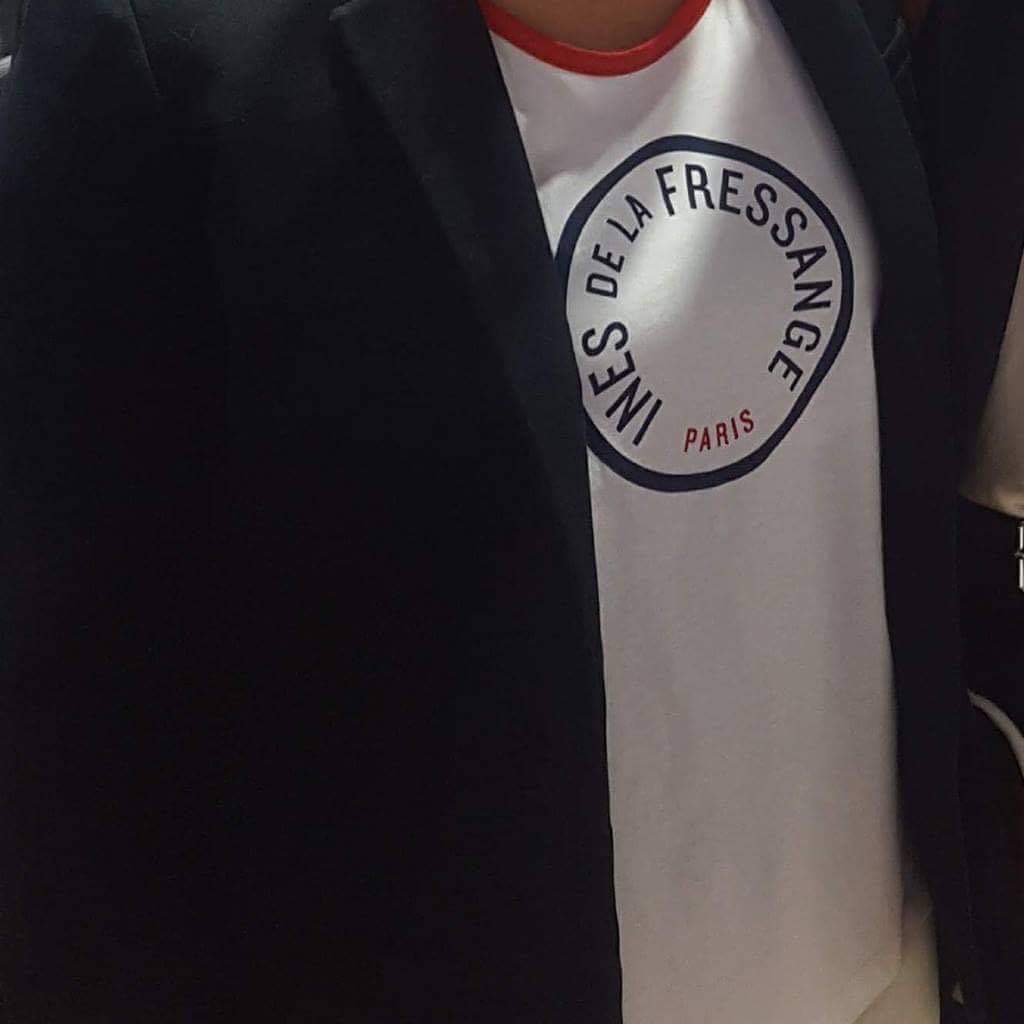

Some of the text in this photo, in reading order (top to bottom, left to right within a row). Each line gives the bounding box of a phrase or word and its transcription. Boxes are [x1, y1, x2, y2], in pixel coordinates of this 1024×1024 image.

[581, 163, 834, 446] INES DE LA FRESSANGE
[683, 408, 755, 453] PARIS
